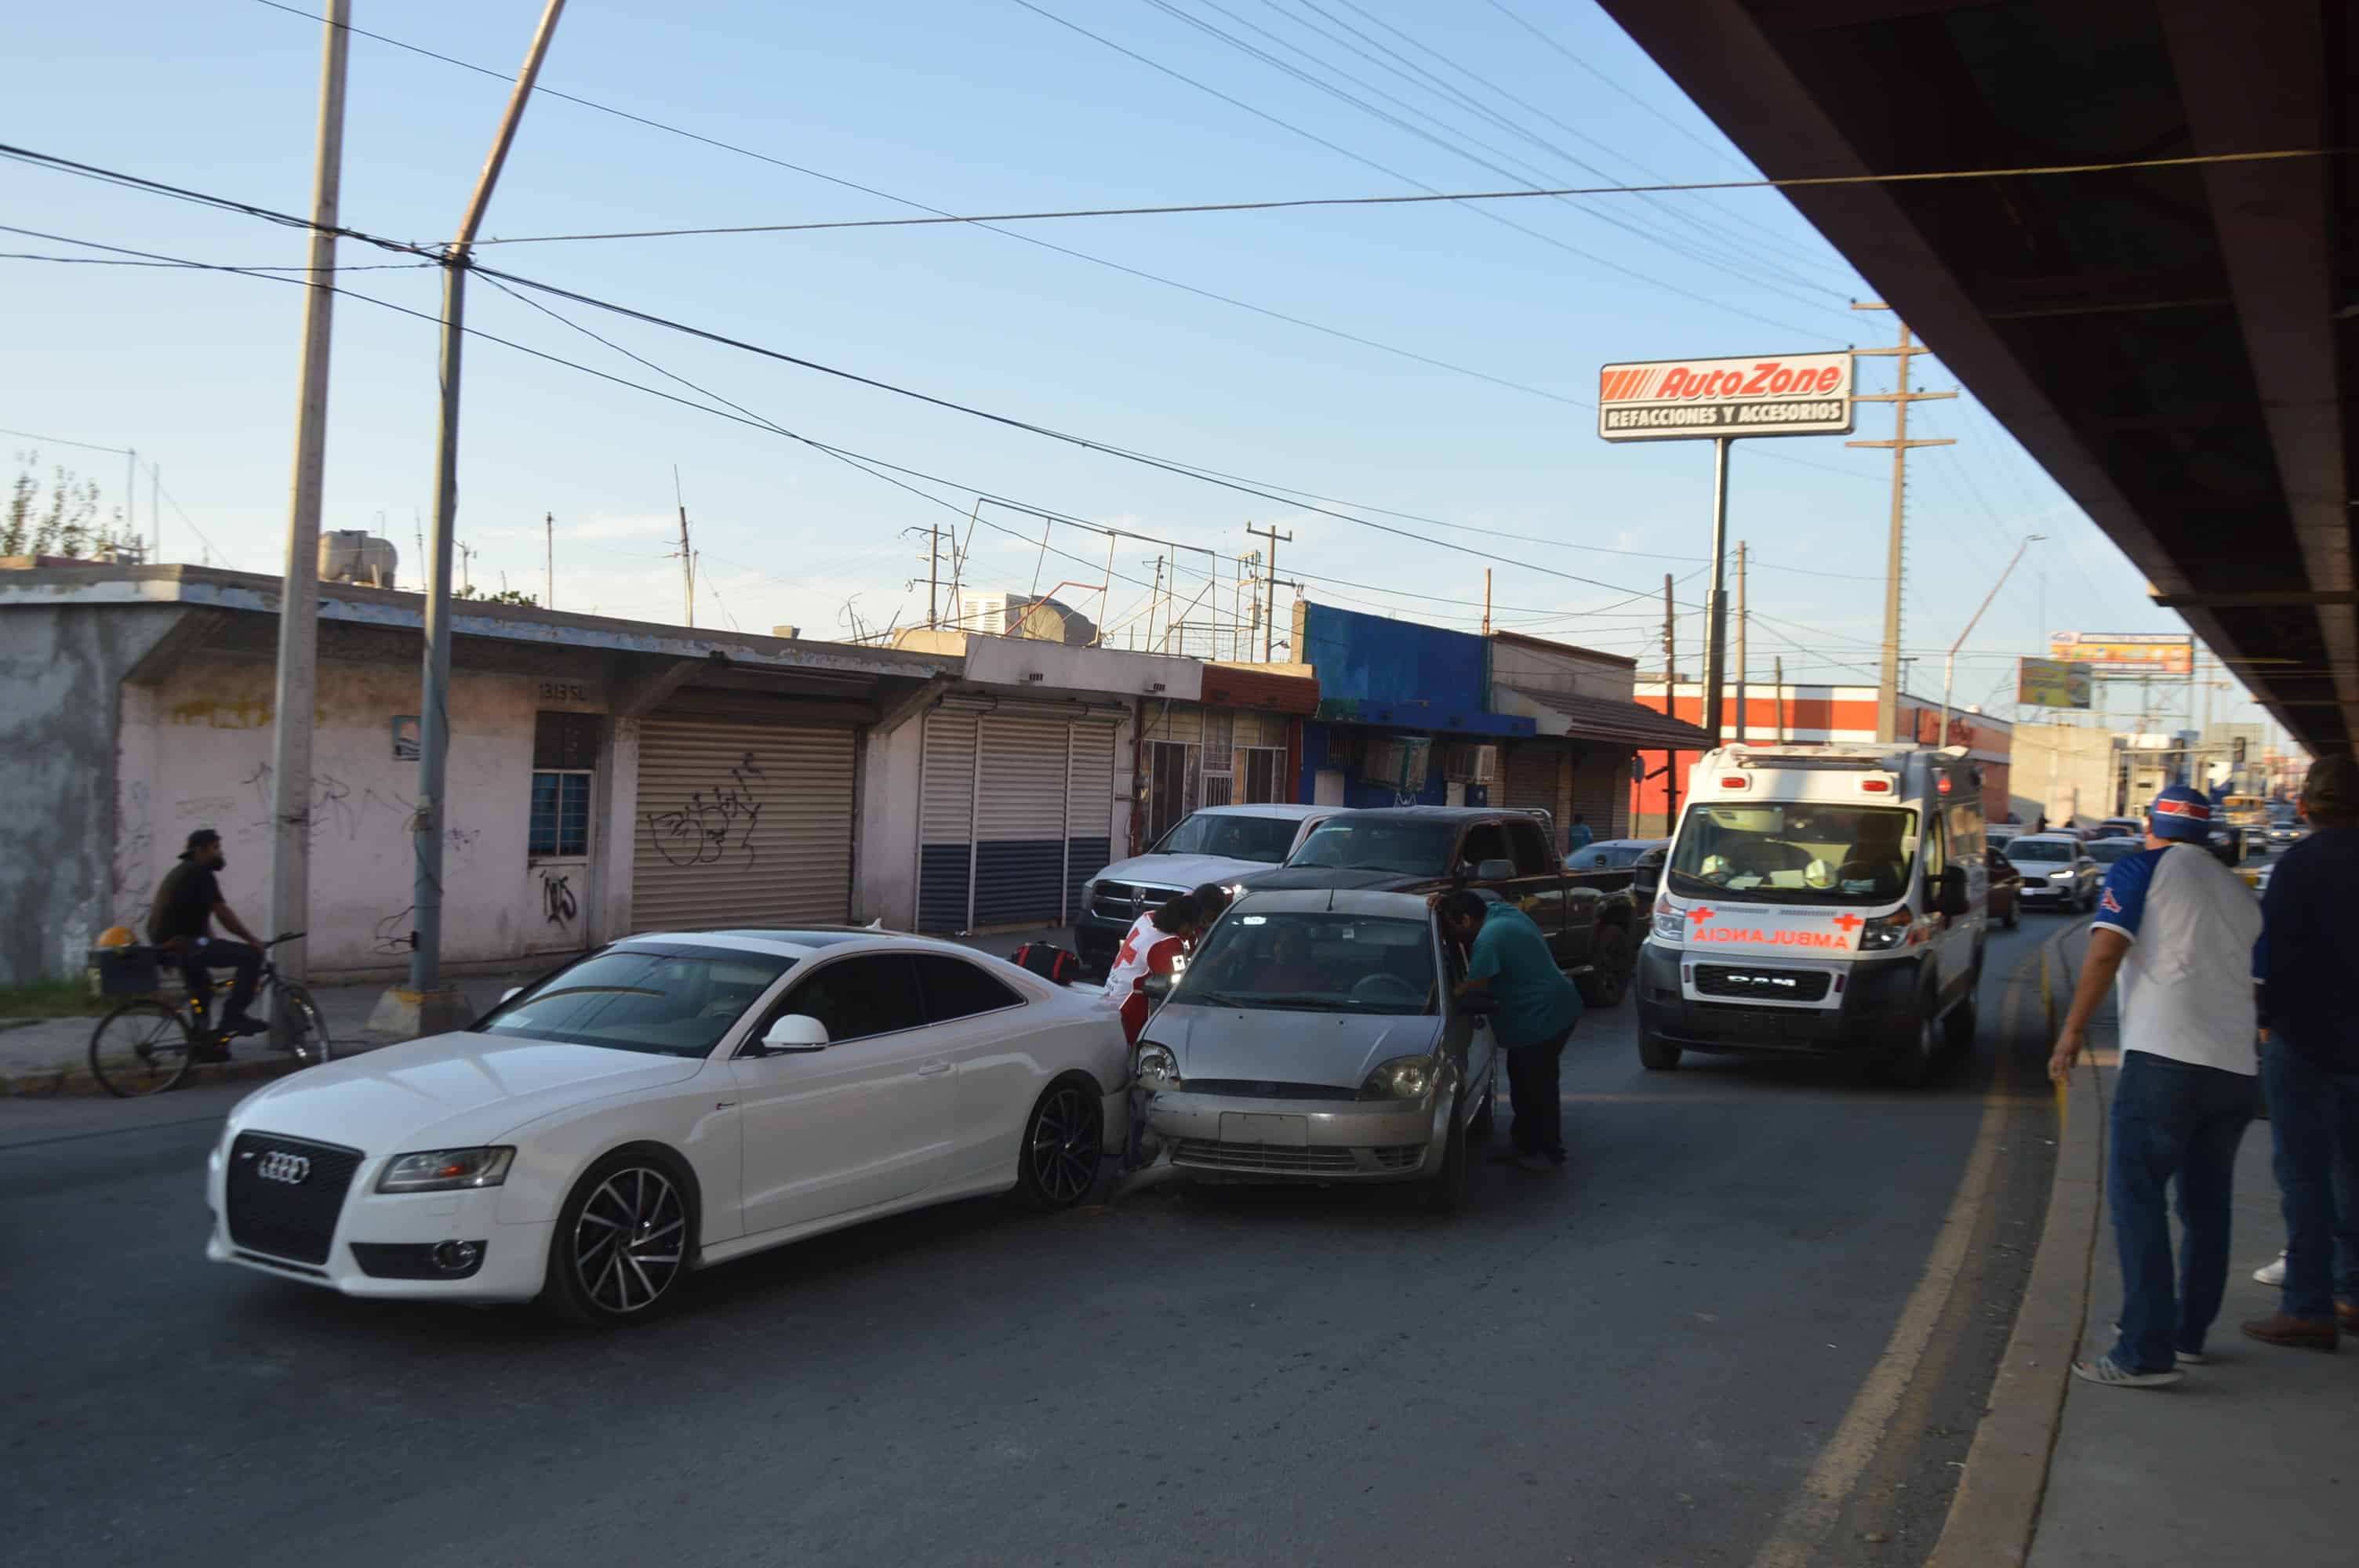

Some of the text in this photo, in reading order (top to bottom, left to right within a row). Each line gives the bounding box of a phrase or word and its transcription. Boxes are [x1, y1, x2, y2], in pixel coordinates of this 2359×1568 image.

[1656, 362, 1843, 398] AutoZone
[1608, 401, 1841, 428] REFACCIONES Y ACCESORIOS
